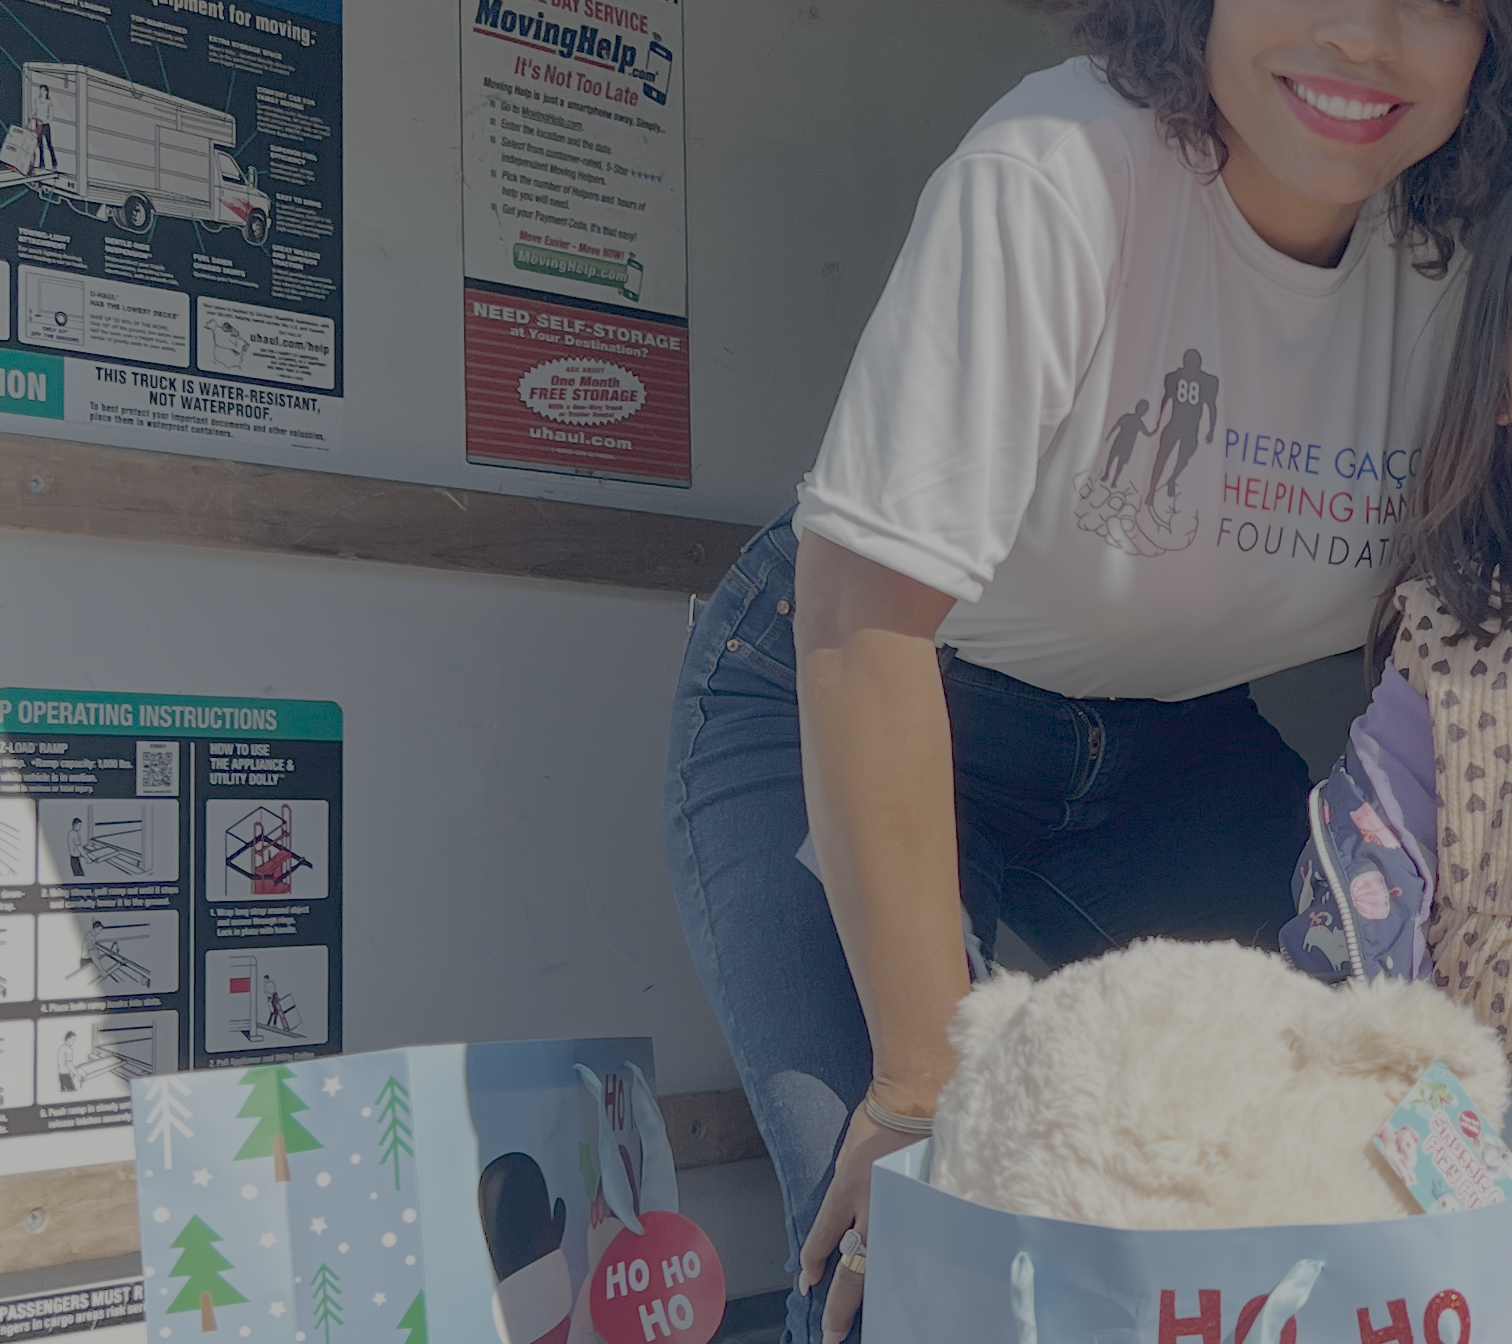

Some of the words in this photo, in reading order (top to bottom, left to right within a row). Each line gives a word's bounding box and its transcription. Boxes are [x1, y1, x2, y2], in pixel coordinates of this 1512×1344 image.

[229, 5, 251, 27] for
[256, 17, 316, 45] moving:
[483, 77, 512, 95] Moving
[515, 85, 531, 100] Help
[514, 56, 541, 80] It's
[544, 65, 572, 89] Not
[576, 73, 601, 96] Too
[605, 80, 638, 106] Late
[518, 250, 628, 284] MovingHelp.com
[473, 302, 530, 324] NEED
[536, 313, 681, 351] SELF-STORAGE
[250, 333, 329, 356] uhaul.com/help
[510, 328, 524, 337] at
[529, 329, 561, 345] Your
[564, 334, 649, 358] Destination?
[96, 366, 126, 384] THIS
[132, 371, 176, 392] TRUCK
[182, 379, 194, 394] IS
[200, 382, 321, 415] WATER-RESISTANT,
[529, 388, 566, 401] FREE
[572, 388, 637, 402] STORAGE
[551, 375, 574, 387] One
[580, 376, 620, 388] Month
[1177, 378, 1200, 406] 88
[90, 413, 112, 423] place
[115, 415, 134, 425] them
[102, 403, 119, 413] best
[121, 406, 149, 419] protect
[151, 410, 169, 421] your
[253, 422, 266, 433] and
[269, 424, 286, 435] other
[150, 391, 175, 407] NOT
[181, 395, 273, 422] WATERPROOF.
[529, 426, 633, 450] uhaul.com
[1225, 428, 1321, 475] PIERRE
[1223, 473, 1354, 524] HELPING
[18, 700, 133, 726] OPERATING
[139, 704, 278, 731] INSTRUCTIONS
[39, 743, 69, 754] RAMP
[209, 743, 234, 755] HOW
[235, 744, 249, 755] TO
[251, 744, 270, 756] USE
[210, 758, 229, 770] THE
[232, 758, 285, 771] APPLIANCE
[286, 759, 295, 771] &
[210, 773, 247, 785] UTILITY
[249, 774, 279, 785] DOLLY
[605, 1074, 625, 1131] HO
[606, 1258, 650, 1299] HO
[661, 1251, 701, 1288] HO
[90, 1286, 131, 1307] MUST
[32, 1319, 42, 1330] in
[44, 1314, 74, 1328] cargo
[76, 1308, 104, 1323] areas
[106, 1304, 126, 1318] risk
[638, 1294, 694, 1342] HO
